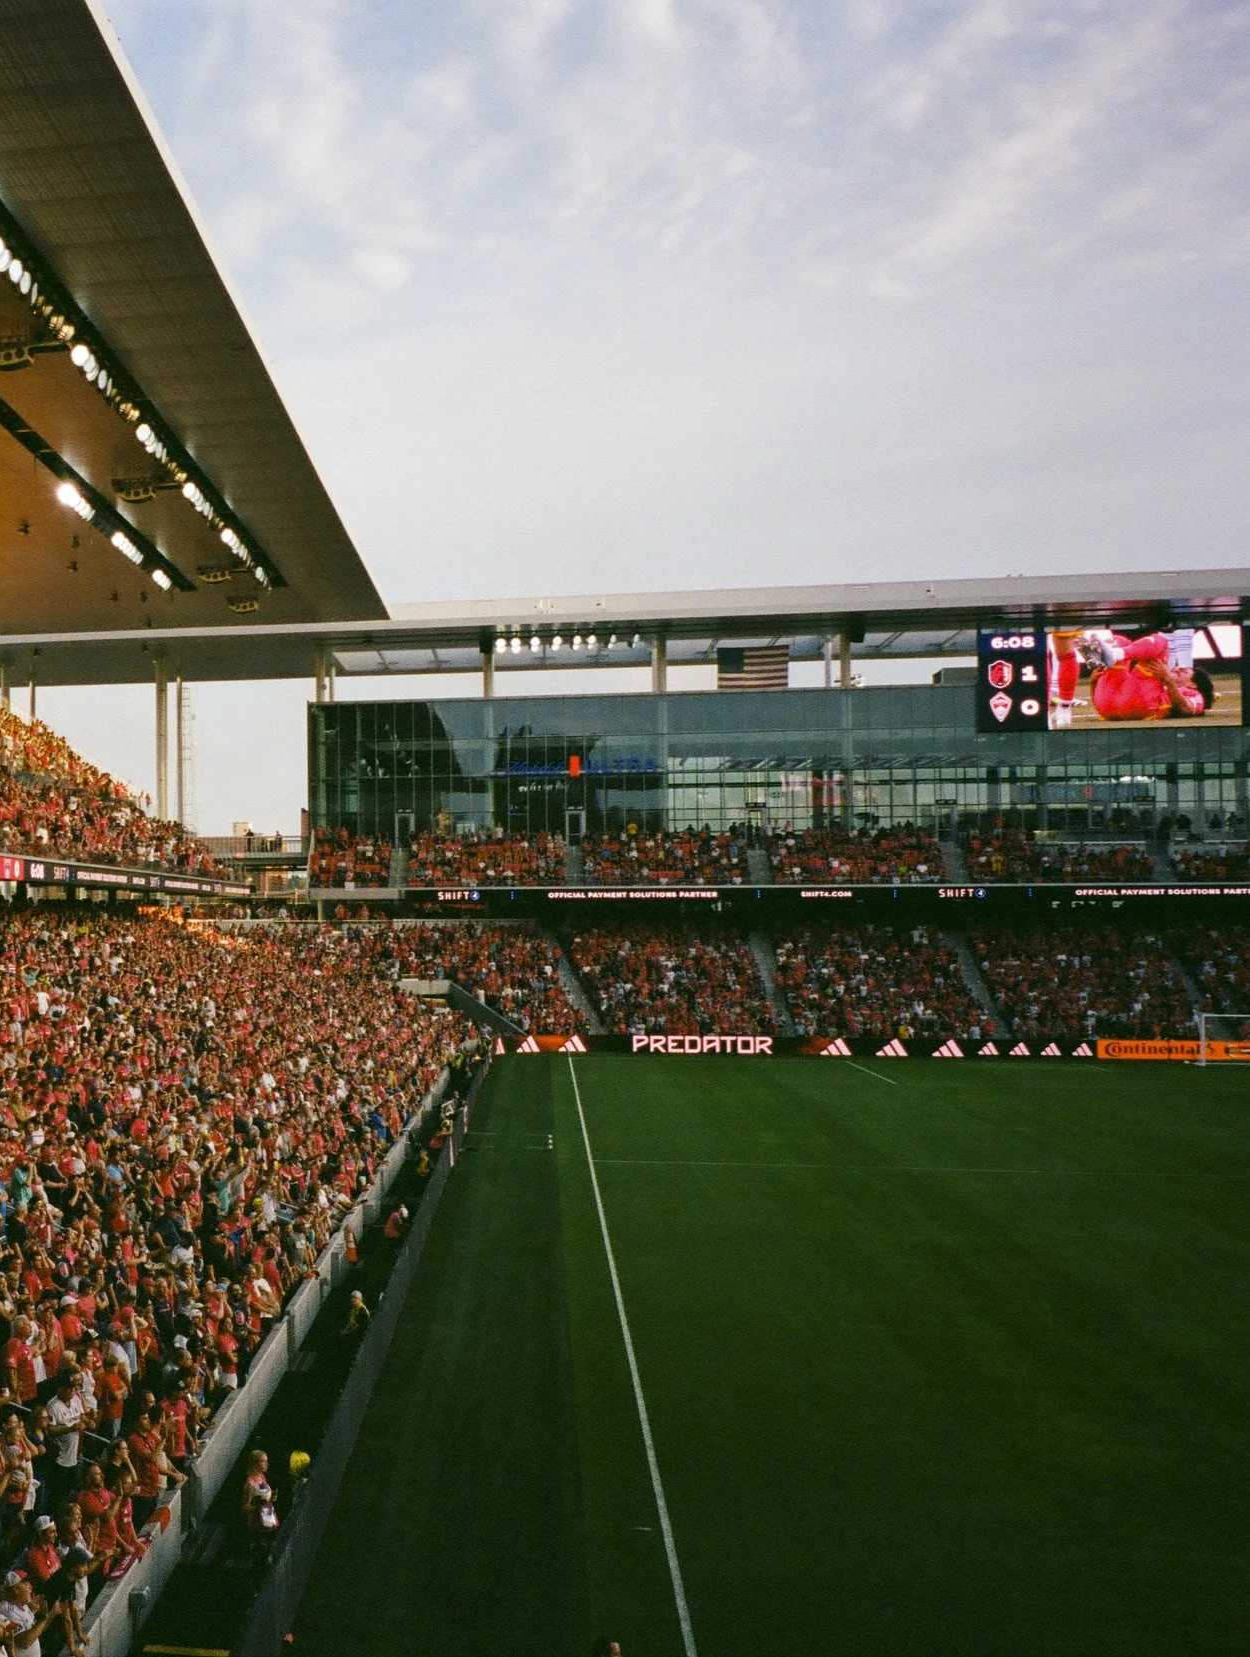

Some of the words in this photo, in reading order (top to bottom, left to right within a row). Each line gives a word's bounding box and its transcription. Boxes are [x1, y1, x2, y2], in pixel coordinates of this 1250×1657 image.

[991, 636, 1035, 649] 6:08
[1021, 665, 1037, 681] 1
[1021, 699, 1039, 715] 0
[801, 890, 852, 898] SHIFT4.COM
[632, 1035, 773, 1054] PREDATOR
